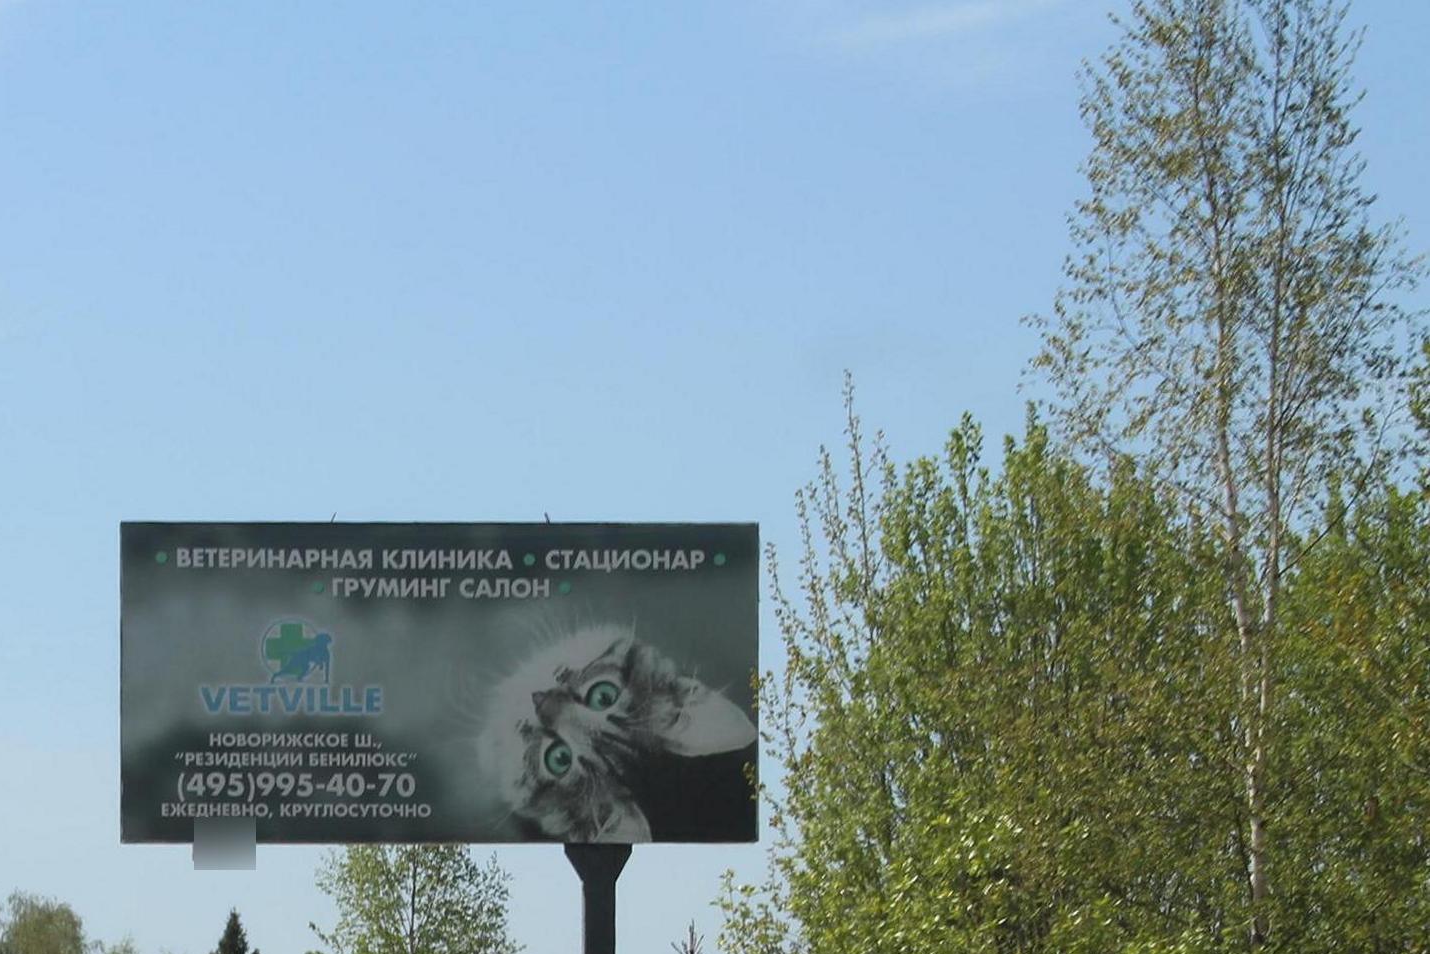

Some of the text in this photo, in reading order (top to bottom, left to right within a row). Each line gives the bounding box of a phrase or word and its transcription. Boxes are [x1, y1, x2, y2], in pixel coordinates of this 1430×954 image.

[176, 548, 705, 573] ВЕТЕРИНАРНАЯ КЛИНИКА СТАЦИОНАР
[332, 578, 550, 599] ГРУМИНГ САЛОН
[200, 685, 384, 714] VETVILLE
[209, 733, 348, 748] НОВОРИЖСКОЕ
[177, 773, 416, 801] (495)995-40-70
[161, 803, 432, 818] ЕЖЕДНЕВНО, КРУГЛОСУТОЧНО
